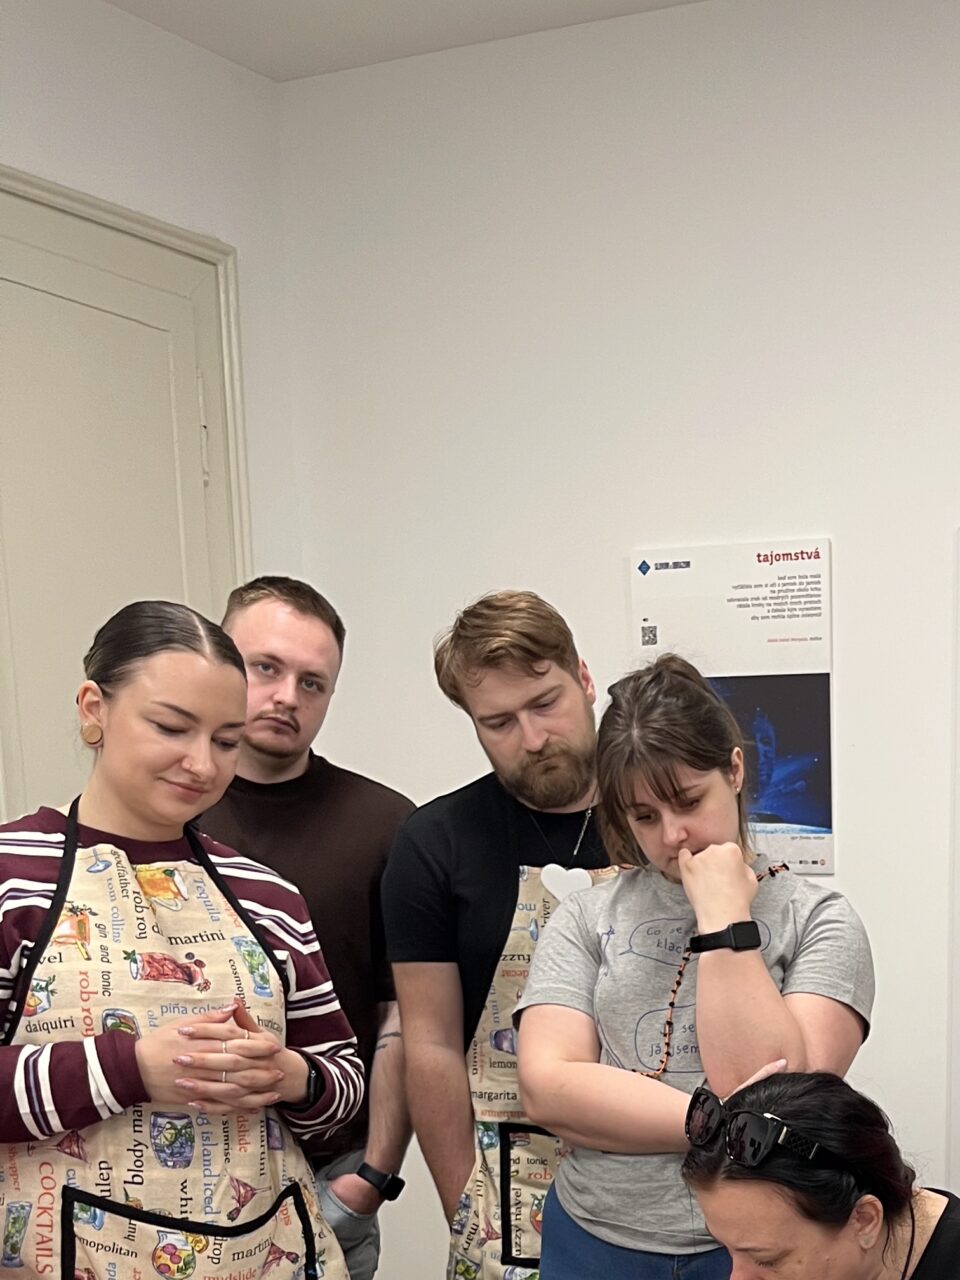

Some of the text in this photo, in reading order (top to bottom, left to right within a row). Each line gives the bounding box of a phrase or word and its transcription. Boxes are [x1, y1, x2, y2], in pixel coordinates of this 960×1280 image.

[757, 548, 820, 566] tajomstvá
[110, 849, 131, 899] godfather
[106, 877, 125, 943] tom collins
[133, 890, 150, 940] rob roy
[193, 878, 221, 922] Tequila
[168, 930, 226, 945] martini
[95, 923, 114, 997] gin and tonic
[25, 1016, 75, 1034] daiquiri
[79, 970, 98, 1037] rob roy
[160, 1003, 188, 1016] piña
[123, 1139, 149, 1187] blody
[201, 1131, 221, 1178] island
[221, 1119, 231, 1164] sunrise
[526, 1157, 548, 1166] tonic
[527, 1168, 553, 1180] rob
[35, 1161, 57, 1275] COCKTAILS
[203, 1183, 221, 1216] iced
[231, 1234, 273, 1262] martini
